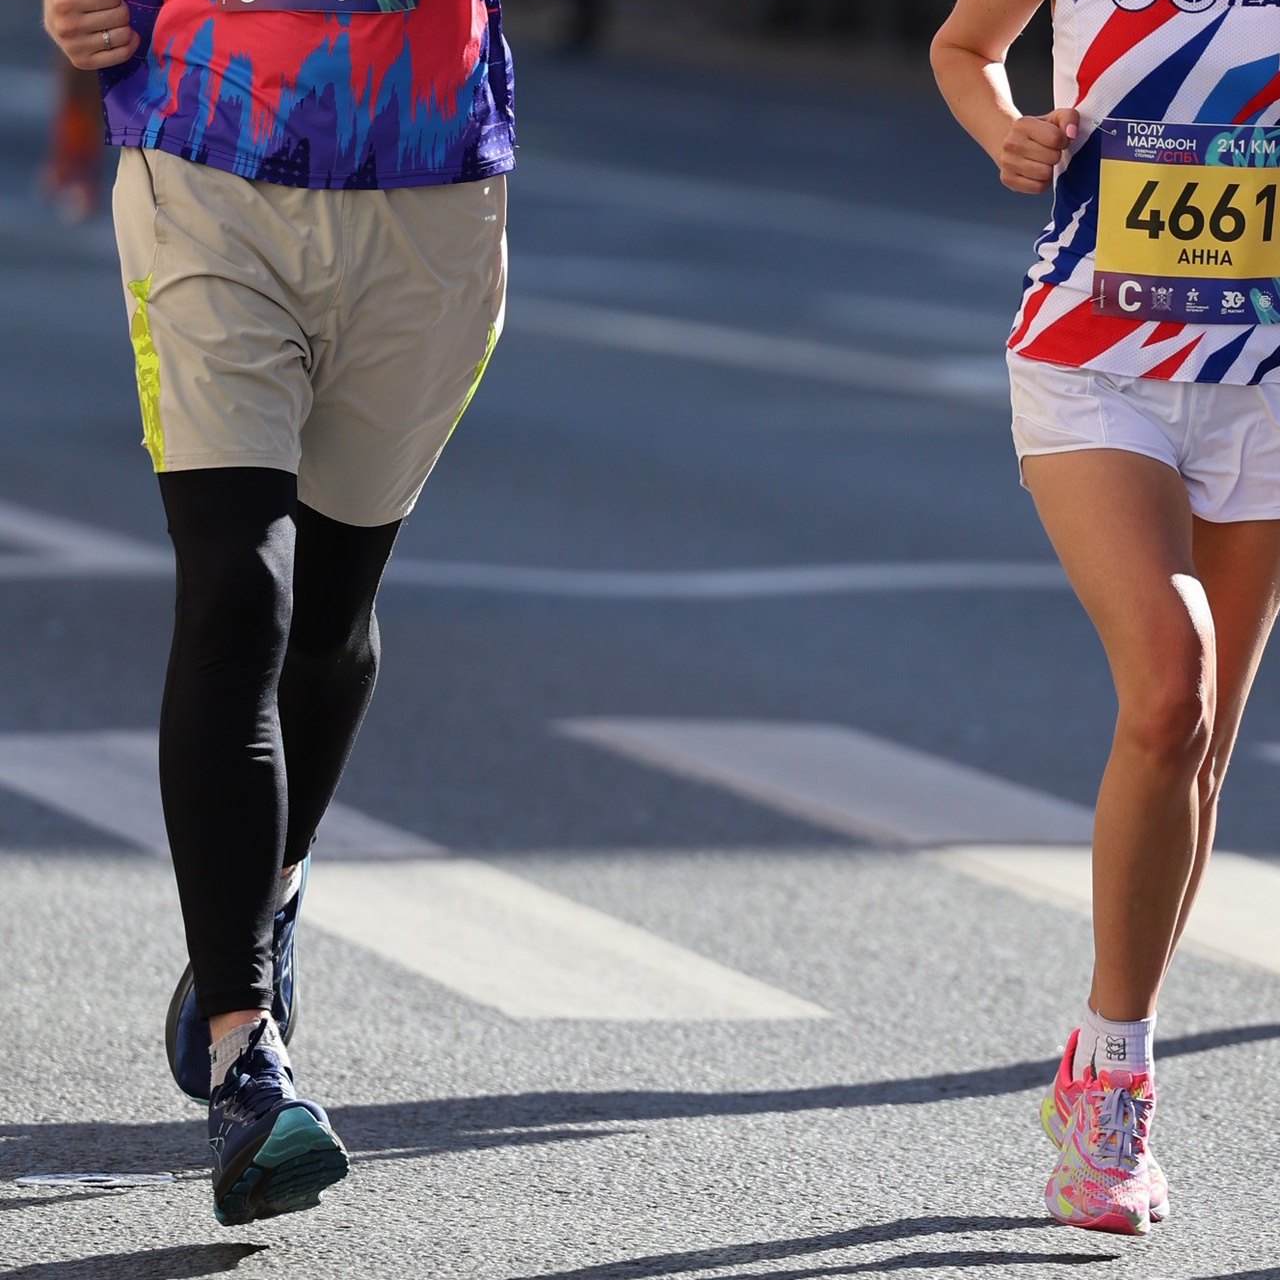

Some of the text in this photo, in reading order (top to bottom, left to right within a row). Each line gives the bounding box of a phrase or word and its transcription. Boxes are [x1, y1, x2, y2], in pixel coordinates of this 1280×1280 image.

[1127, 122, 1165, 136] ПОЛУ
[1126, 135, 1197, 151] МАРАФОН
[1217, 139, 1276, 156] 21,1 КМ
[1125, 180, 1277, 242] 4661
[1177, 248, 1233, 266] АННА
